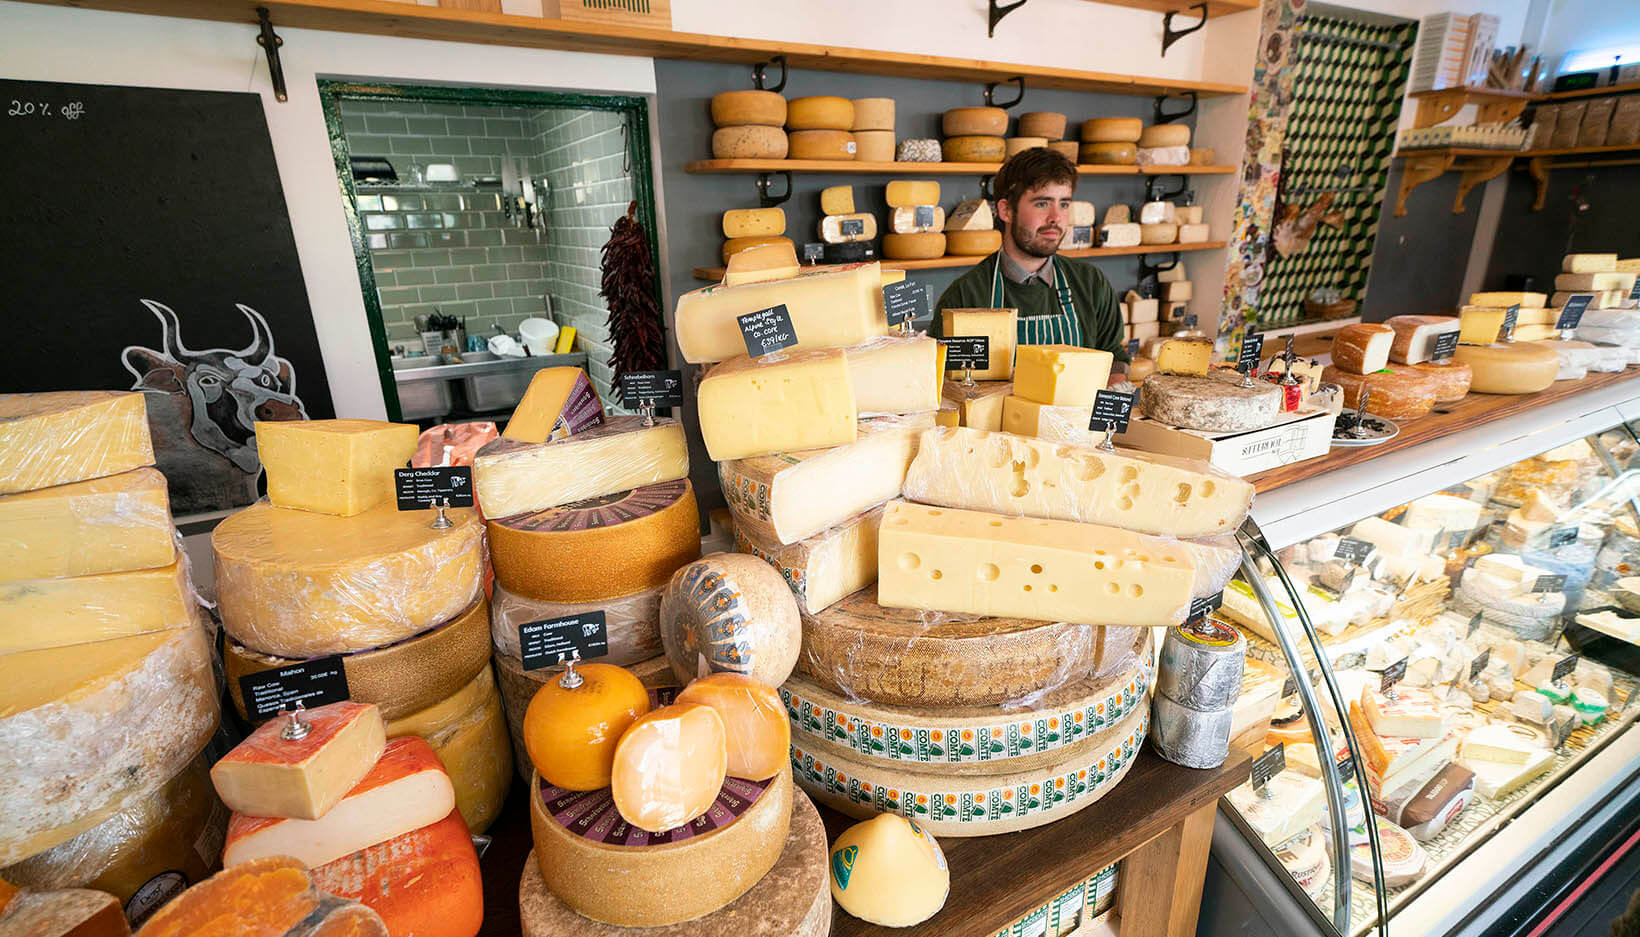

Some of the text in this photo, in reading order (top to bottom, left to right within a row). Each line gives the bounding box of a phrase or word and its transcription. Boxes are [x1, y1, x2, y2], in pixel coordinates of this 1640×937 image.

[61, 102, 86, 120] off
[523, 619, 580, 634] Edam Farmhouse
